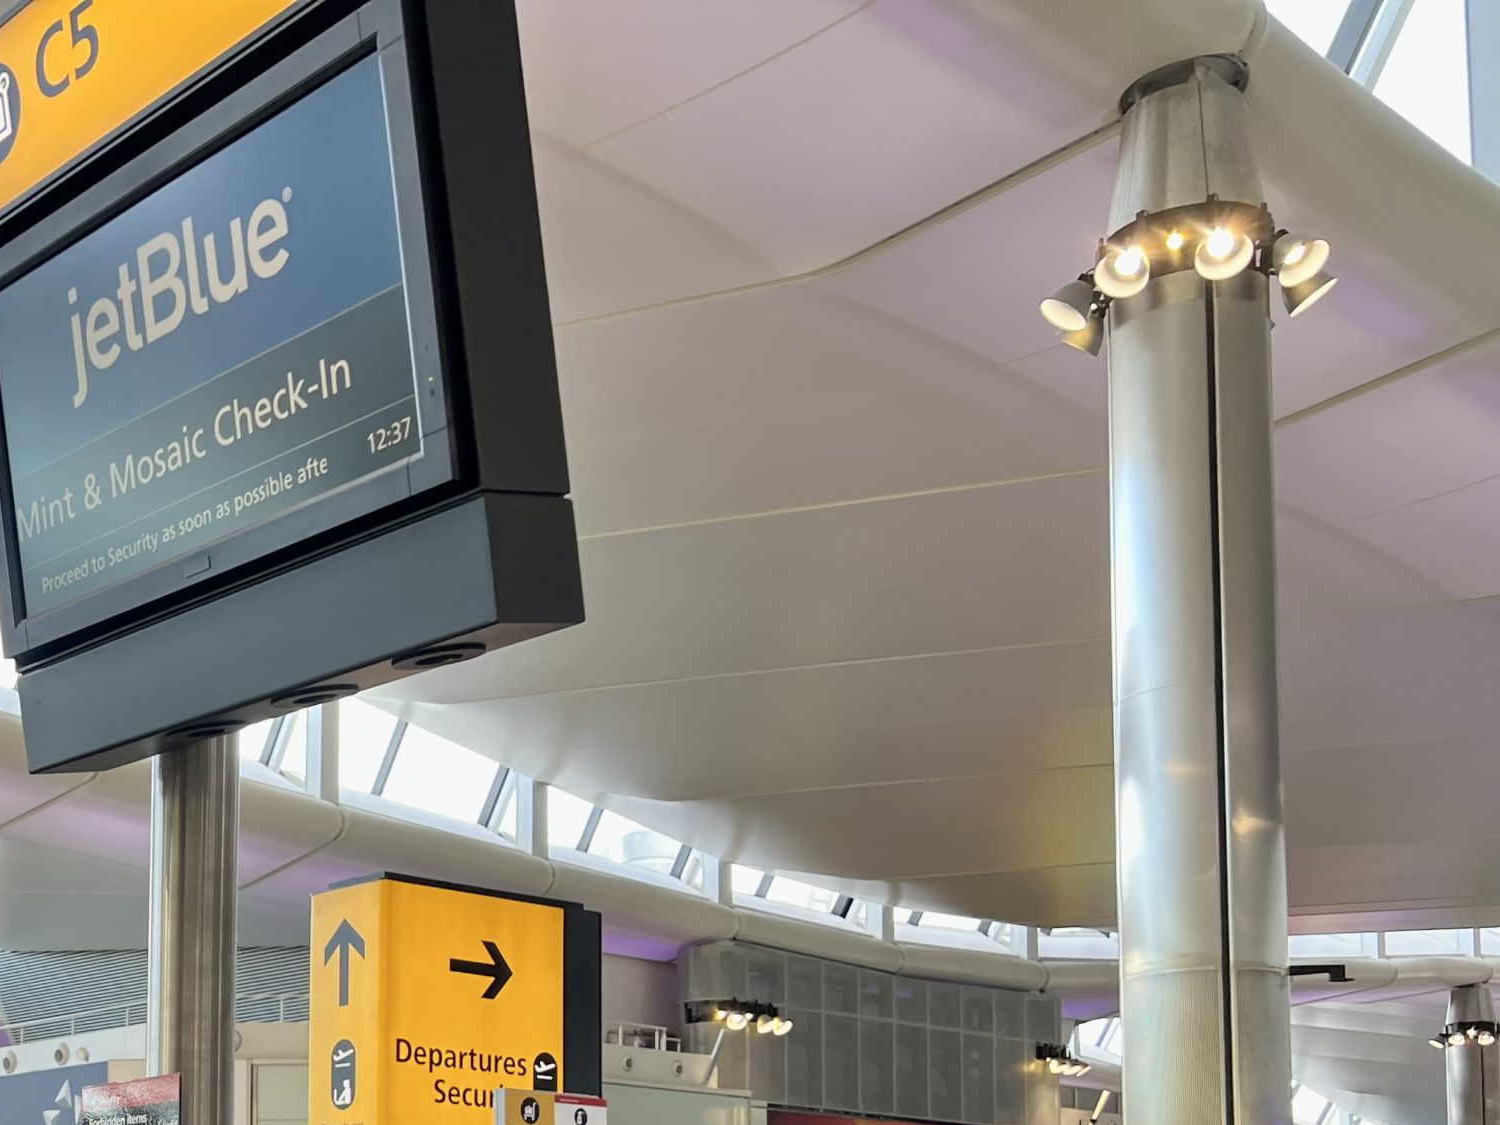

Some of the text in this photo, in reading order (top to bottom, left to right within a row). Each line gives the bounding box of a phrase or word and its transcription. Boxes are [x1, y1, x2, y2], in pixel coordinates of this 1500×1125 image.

[35, 0, 100, 98] C5
[16, 357, 352, 541] Mint & Mosaic Check-In
[367, 416, 411, 455] 12:37
[42, 455, 328, 594] Proceed to Security as soon as possible afte
[395, 1038, 527, 1076] Departures
[434, 1079, 493, 1108] Secur
